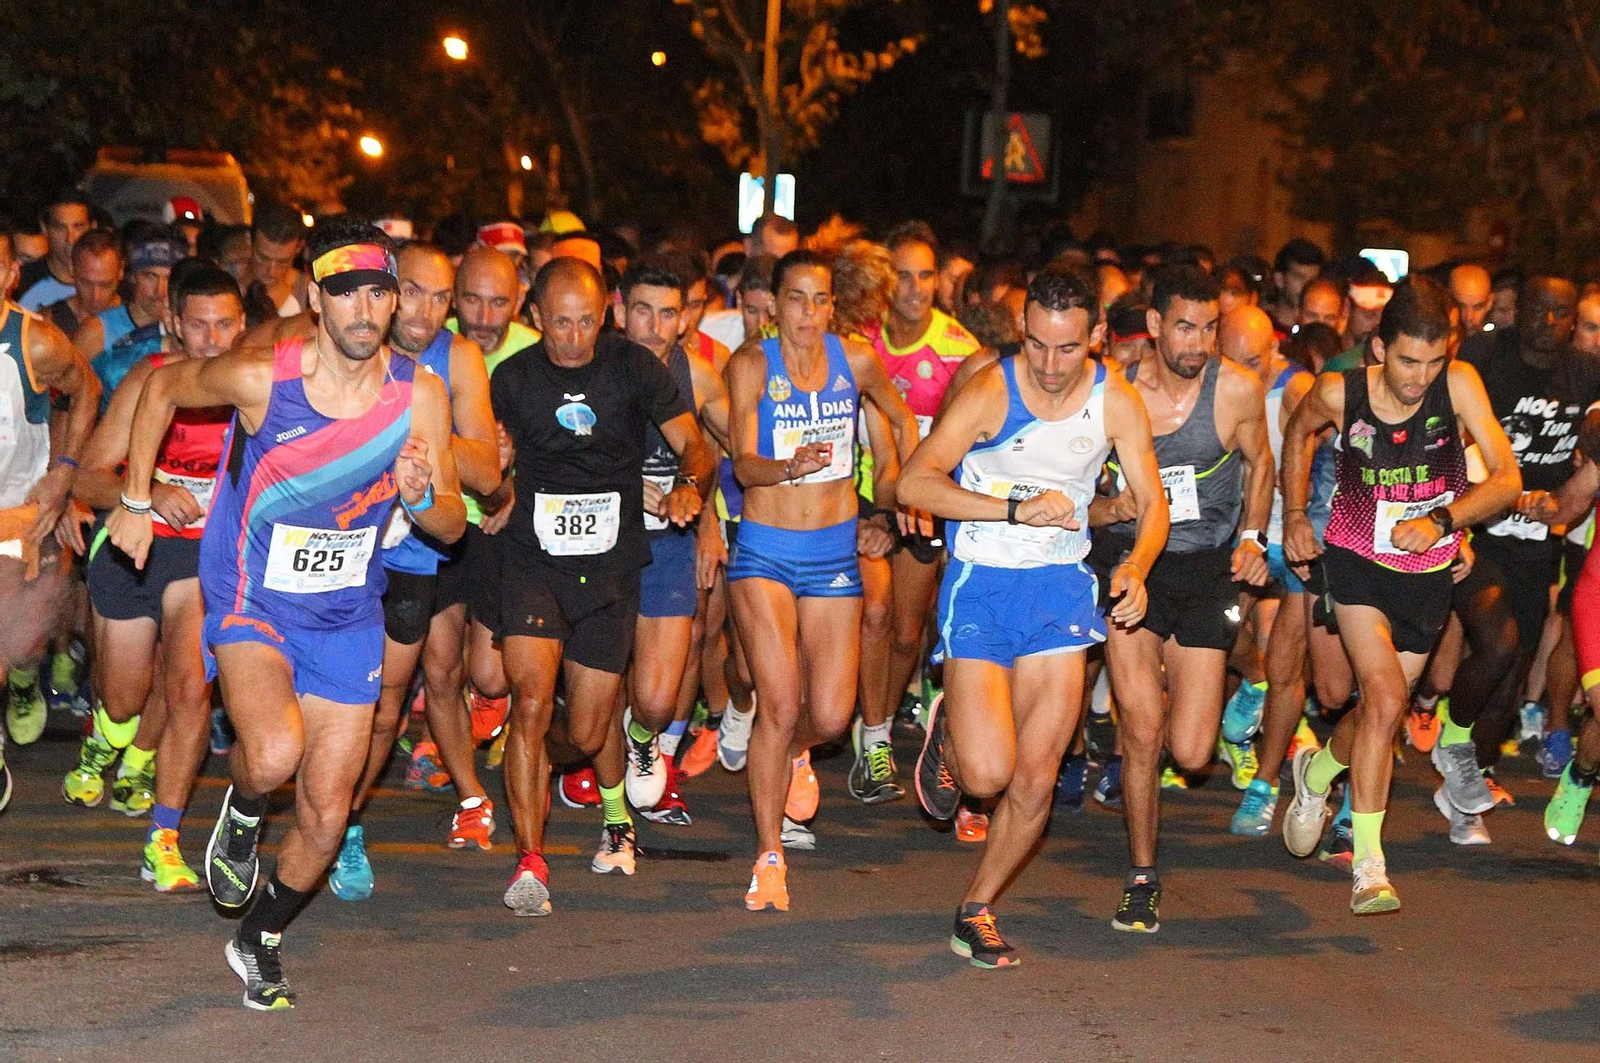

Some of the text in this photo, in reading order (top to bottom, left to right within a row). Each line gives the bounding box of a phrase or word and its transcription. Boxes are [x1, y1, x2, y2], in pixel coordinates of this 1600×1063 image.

[773, 399, 853, 418] ANA DIAS
[1513, 396, 1559, 419] NOC
[803, 424, 846, 436] NOCTURNA
[1539, 420, 1572, 437] TUR
[1552, 435, 1579, 453] NA
[1378, 466, 1412, 486] COSTA
[1415, 464, 1430, 483] DE
[564, 497, 611, 506] NOCTURNA
[554, 514, 597, 535] 382
[309, 531, 367, 541] NOCTURNA
[323, 540, 363, 550] HUELVA
[292, 549, 345, 572] 625
[213, 857, 248, 892] BROOKS
